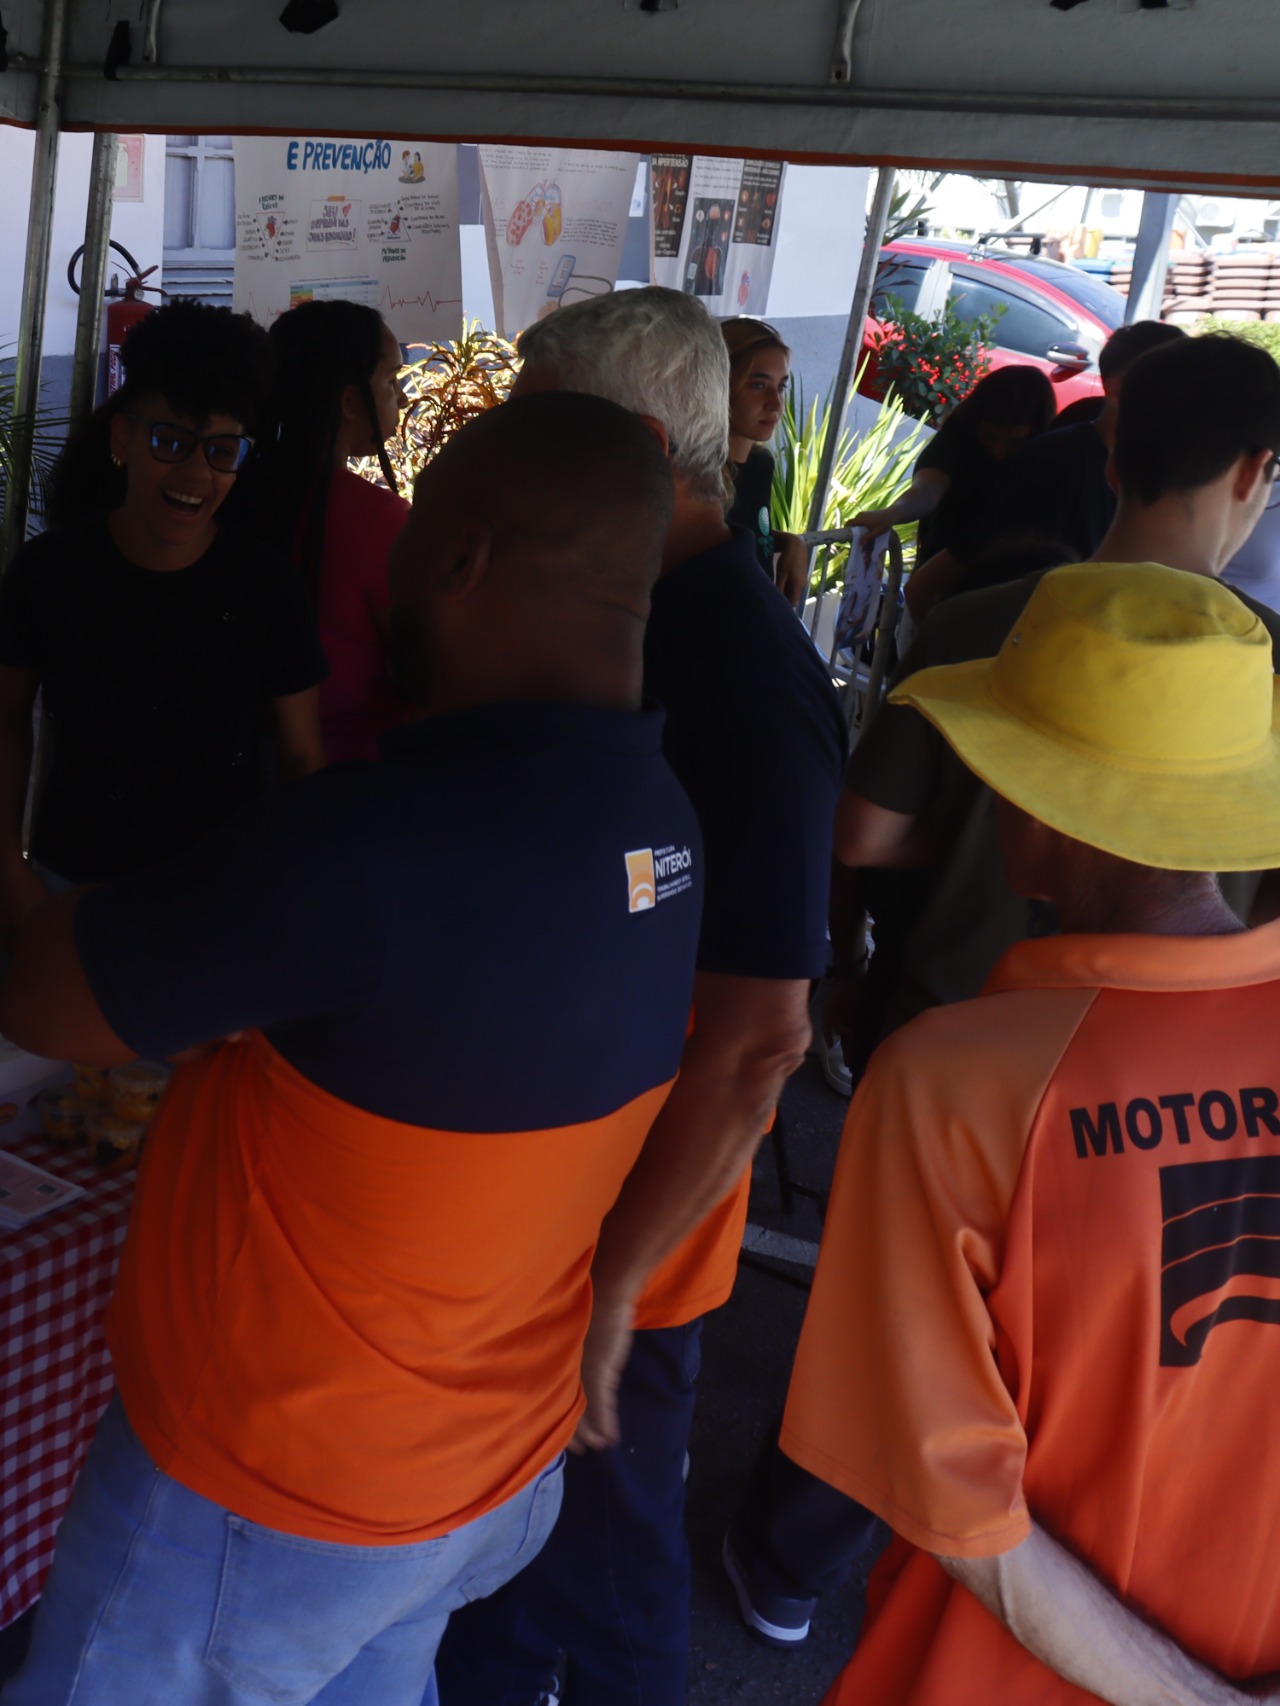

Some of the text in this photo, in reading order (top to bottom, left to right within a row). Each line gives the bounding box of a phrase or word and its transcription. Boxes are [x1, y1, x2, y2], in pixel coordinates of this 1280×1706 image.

[287, 138, 392, 174] E PREVENÇÃO
[654, 845, 692, 879] NITERÓI
[1069, 1087, 1280, 1158] MOTOR
